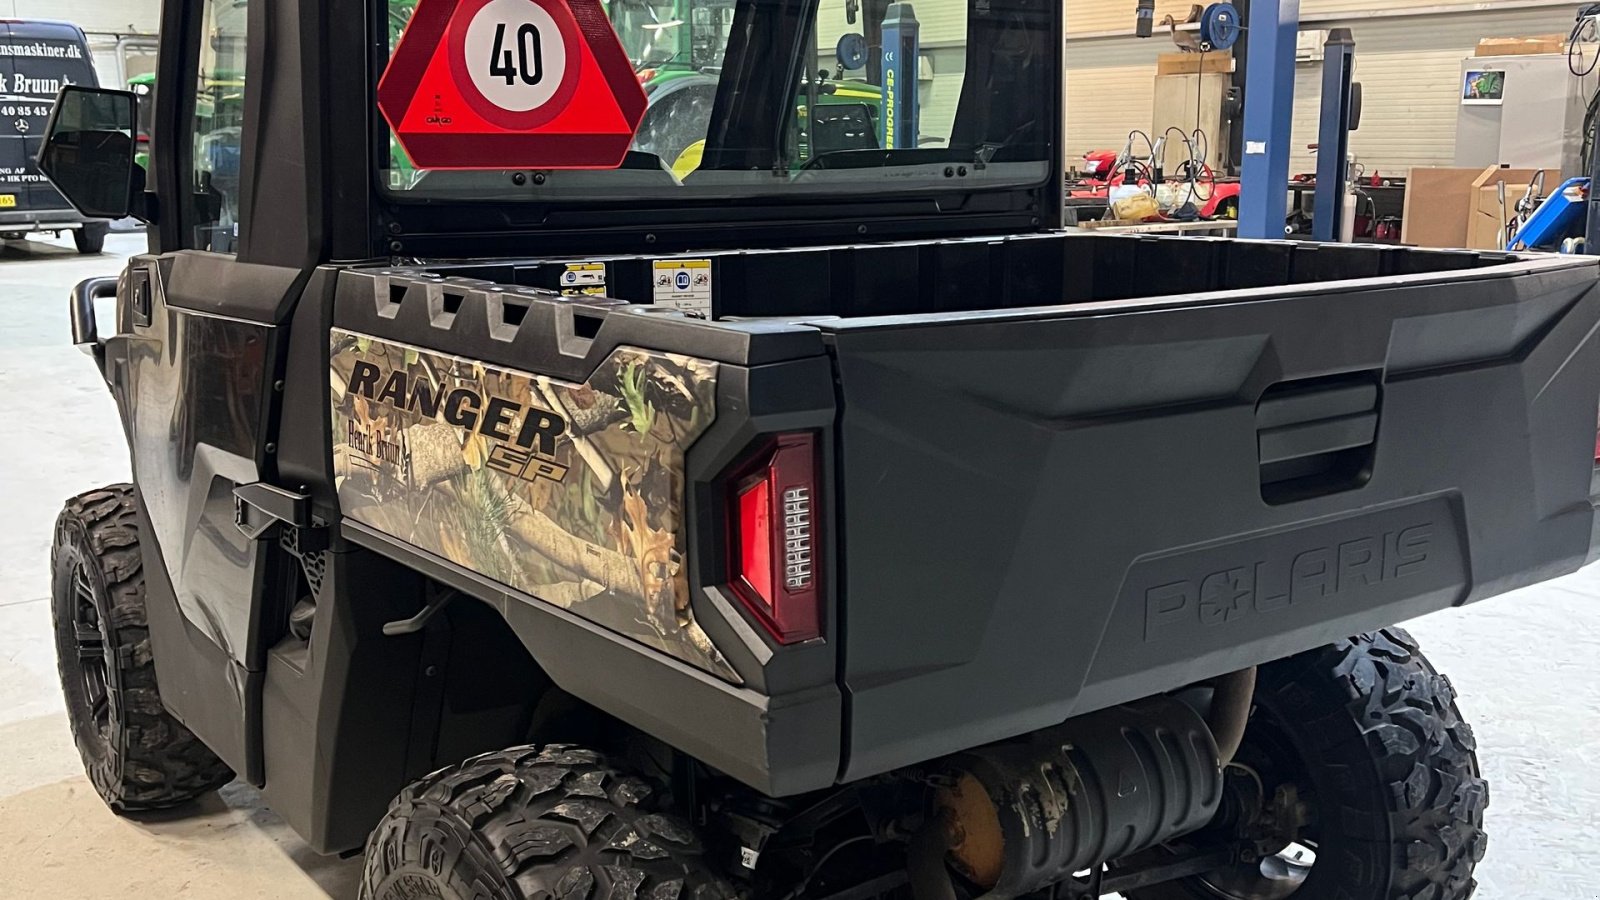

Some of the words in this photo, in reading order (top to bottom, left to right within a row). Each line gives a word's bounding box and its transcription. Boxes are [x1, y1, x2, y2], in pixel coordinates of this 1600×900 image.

[489, 23, 543, 86] 40
[13, 73, 59, 94] Bruun
[347, 359, 566, 457] RANGER
[348, 419, 374, 456] Henrik
[376, 429, 400, 467] Bruun
[485, 444, 570, 483] SP
[1143, 522, 1433, 643] POLARIS
